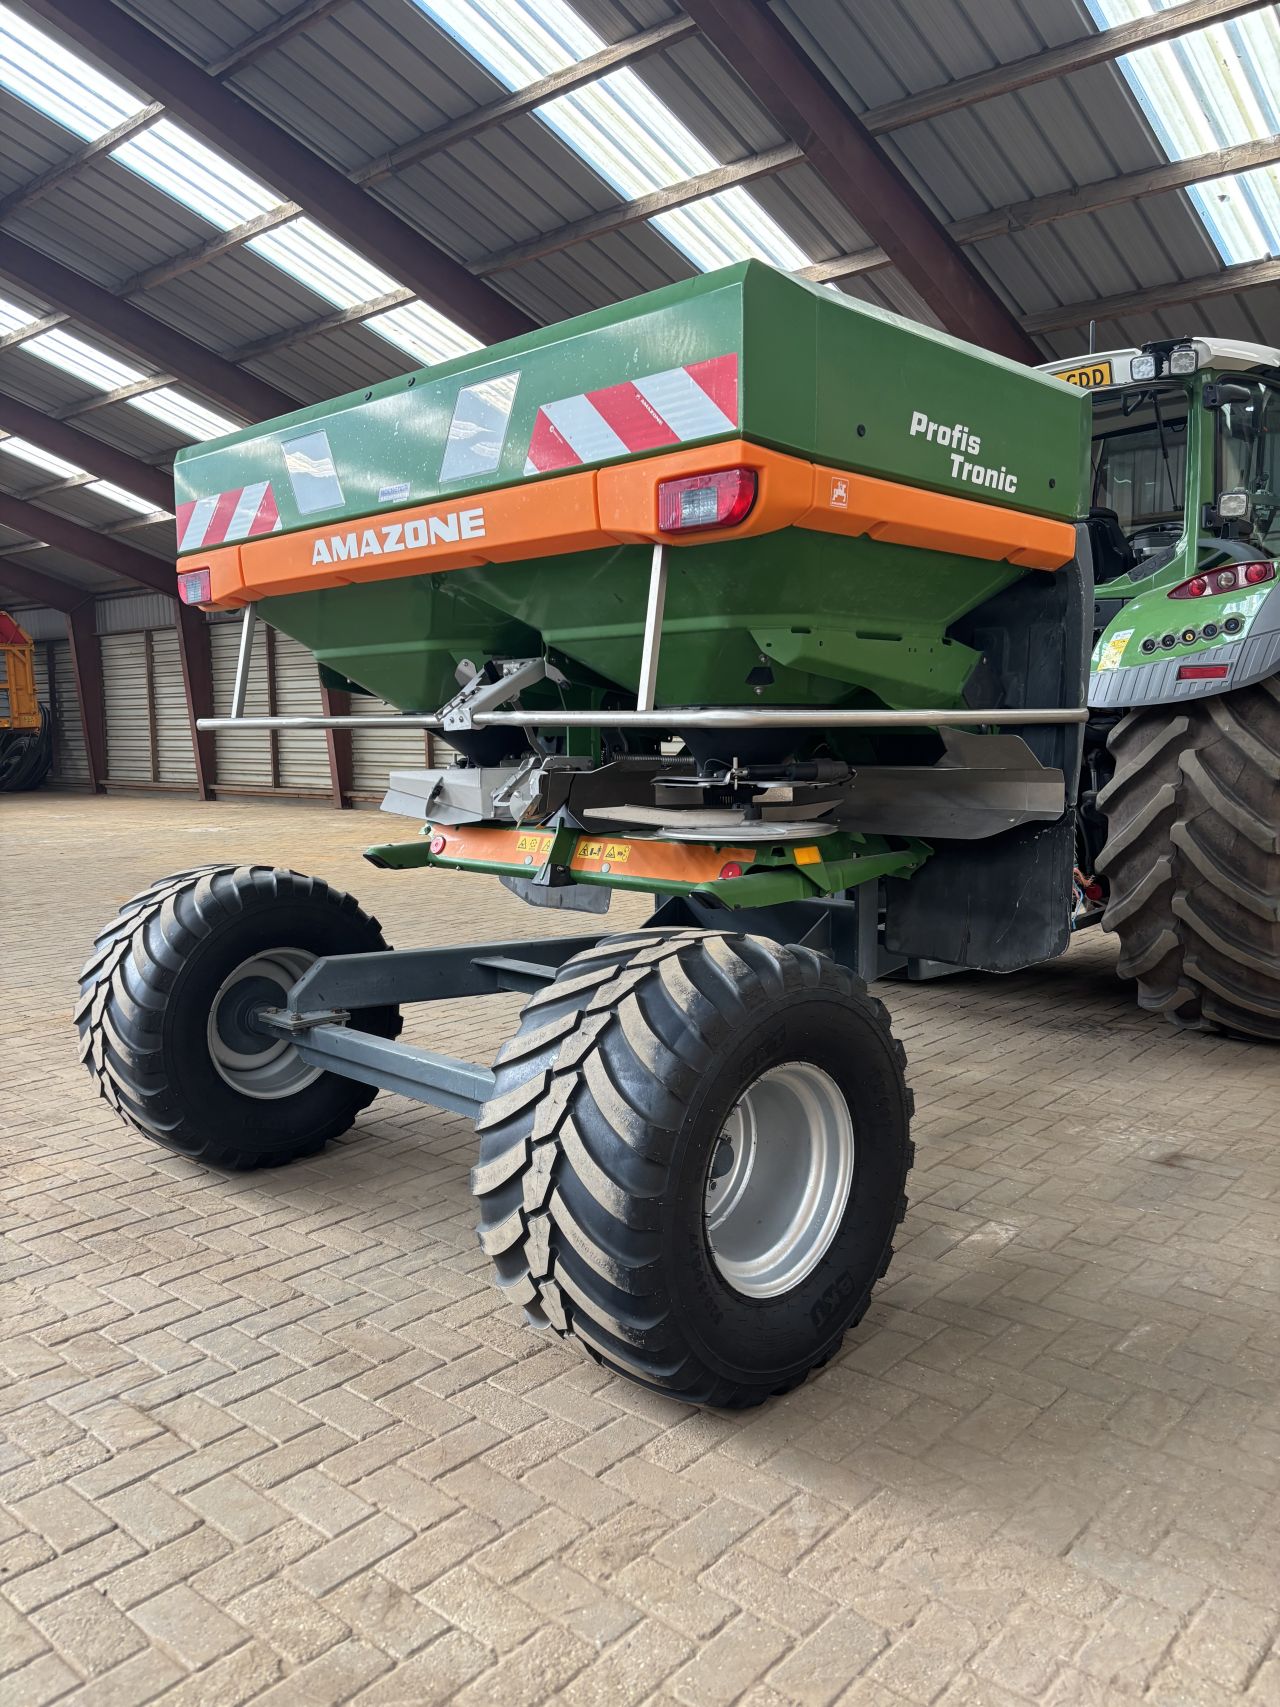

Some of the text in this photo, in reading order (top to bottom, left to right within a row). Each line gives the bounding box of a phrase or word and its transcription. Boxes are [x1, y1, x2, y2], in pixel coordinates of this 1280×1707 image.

[640, 398, 664, 426] AMAZONE
[909, 410, 981, 456] Profis
[950, 452, 1018, 494] Tronic
[312, 507, 486, 566] AMAZONE
